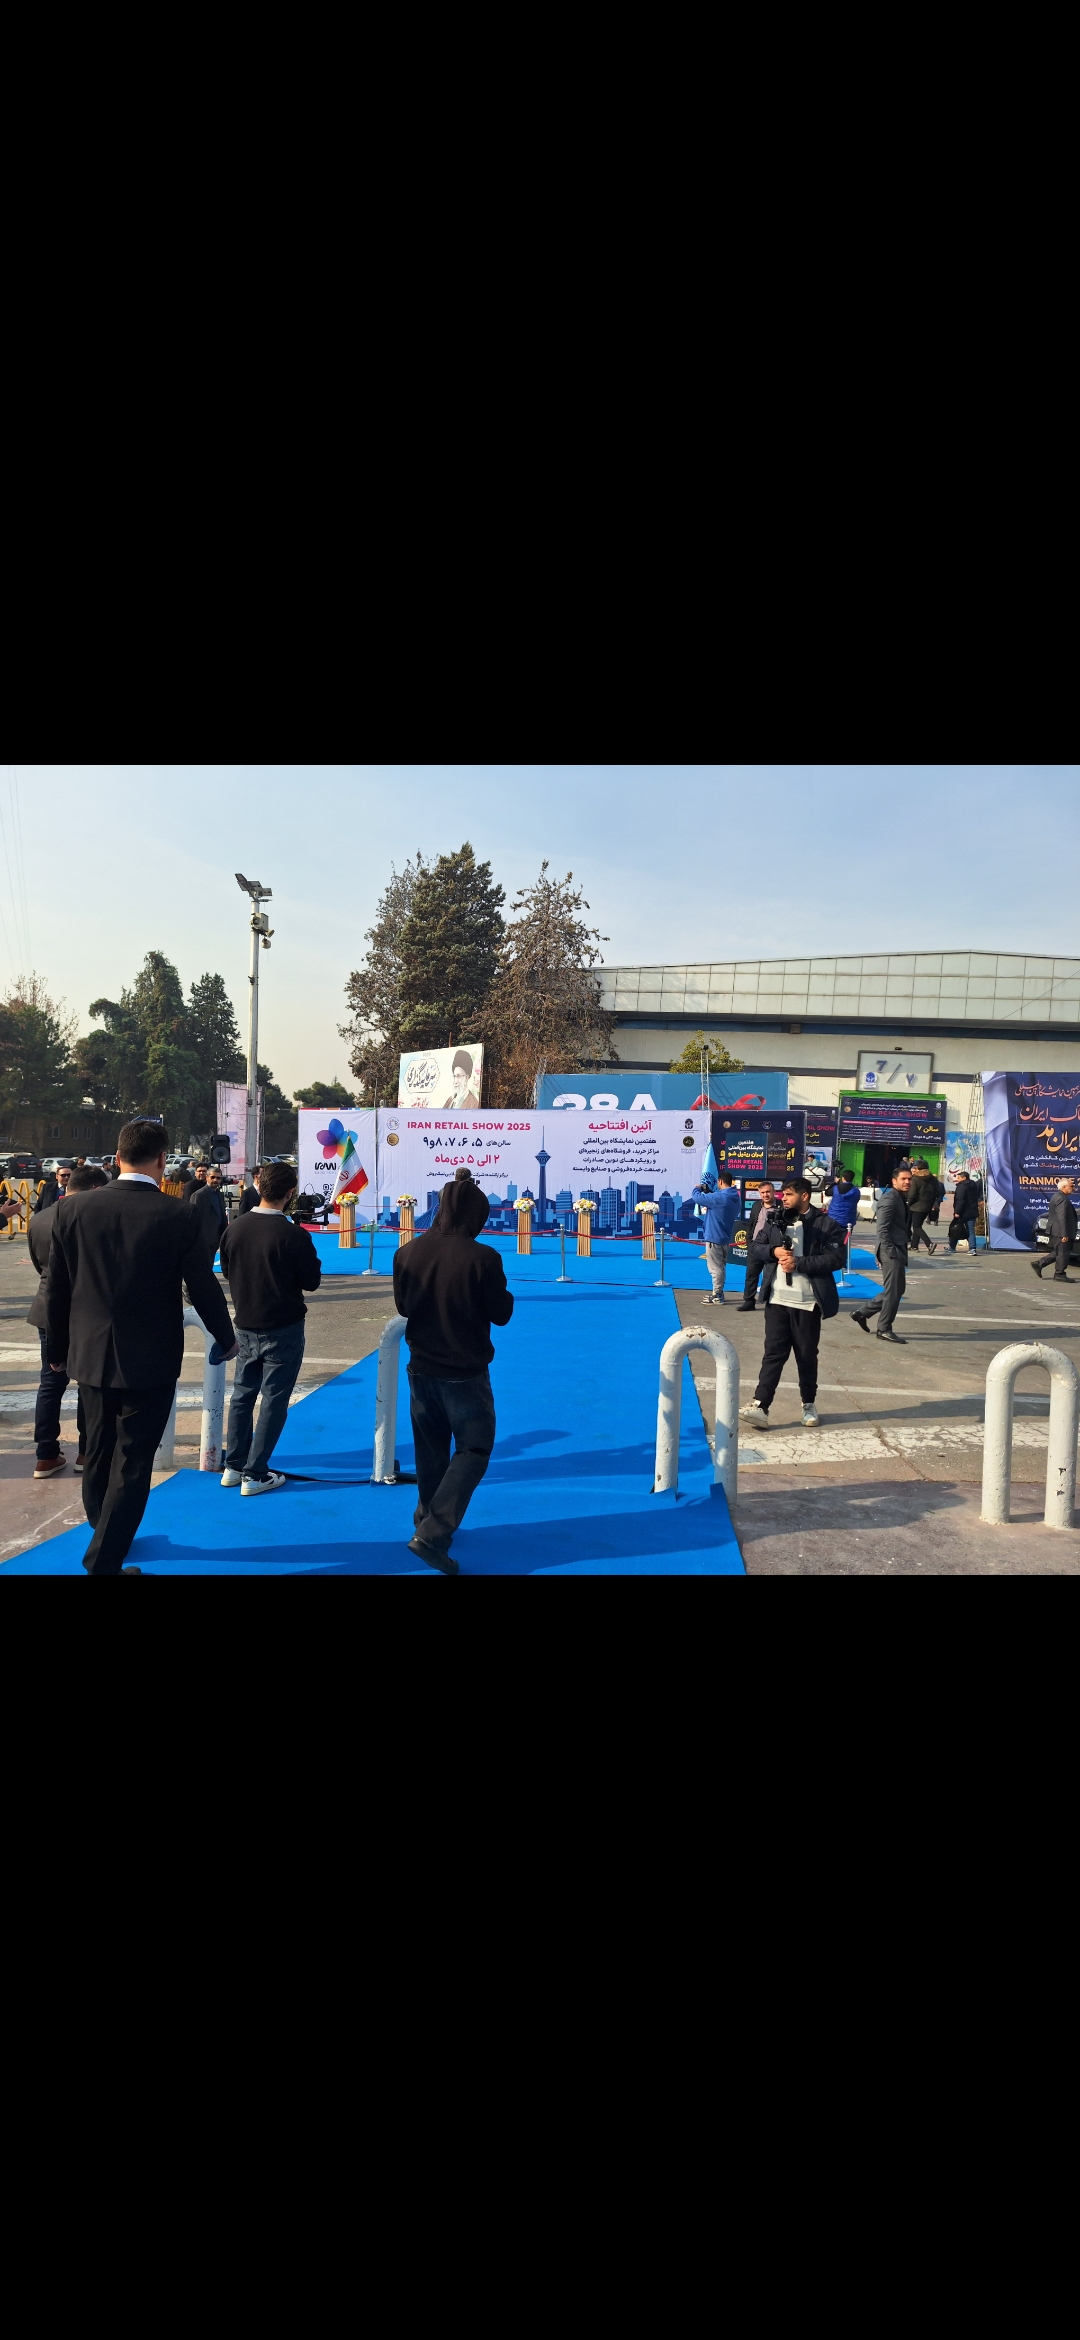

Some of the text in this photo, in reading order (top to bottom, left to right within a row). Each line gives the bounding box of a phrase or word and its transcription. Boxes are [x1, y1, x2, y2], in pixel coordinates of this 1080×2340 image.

[407, 1121, 531, 1131] IRAN RETAIL SHOW 2025
[588, 1119, 652, 1133] آئین افتتاحیه
[609, 1137, 634, 1145] نمایشگاه
[466, 1154, 475, 1163] ۵
[476, 1154, 491, 1167] الی
[493, 1154, 500, 1164] ۲
[572, 1165, 590, 1173] وابسته
[590, 1165, 607, 1173] صنایع
[1019, 1176, 1076, 1187] IRANMOE
